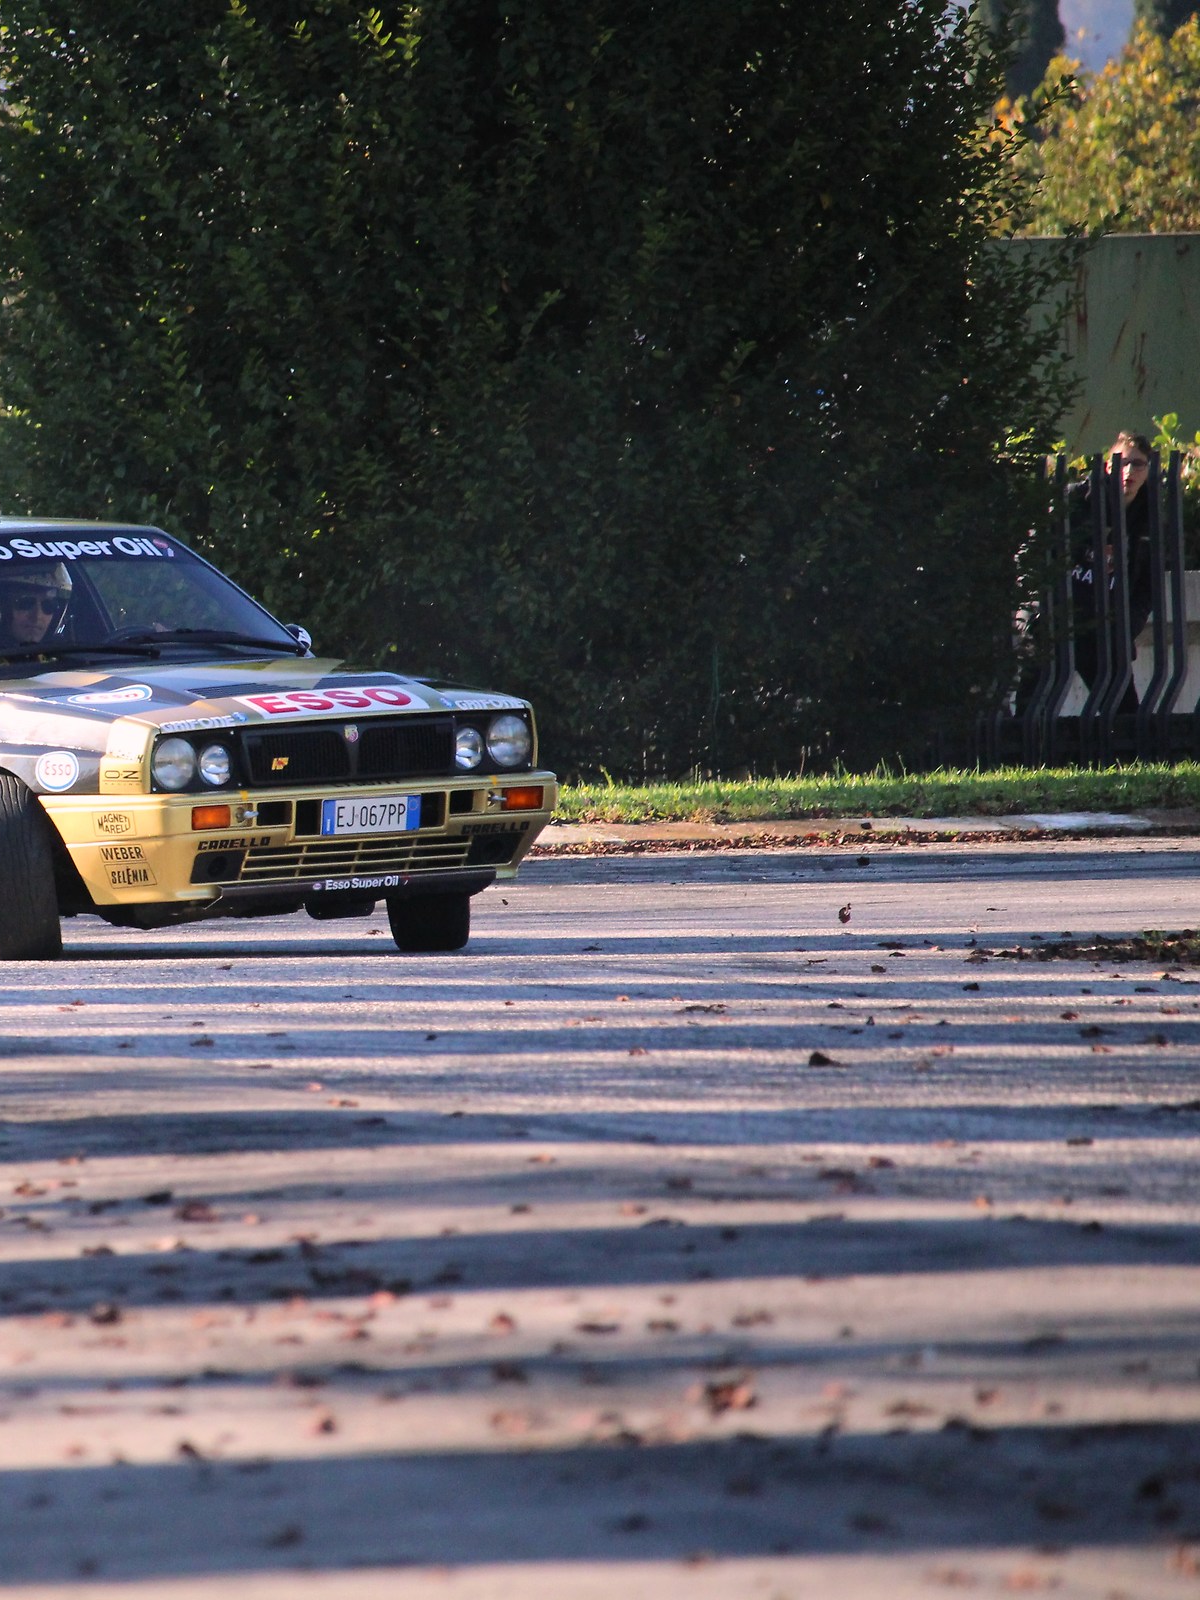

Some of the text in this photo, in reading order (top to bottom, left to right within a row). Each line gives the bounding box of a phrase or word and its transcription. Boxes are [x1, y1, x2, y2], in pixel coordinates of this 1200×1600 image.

[9, 538, 112, 560] Super
[112, 537, 162, 556] Oil
[248, 688, 412, 714] ESSO
[461, 821, 530, 835] CARELLO
[198, 836, 271, 851] CARELLO
[100, 846, 144, 861] WEBER
[111, 867, 149, 885] SELENIA
[325, 880, 350, 891] Esso
[351, 878, 383, 890] Super
[384, 876, 399, 887] Oil
